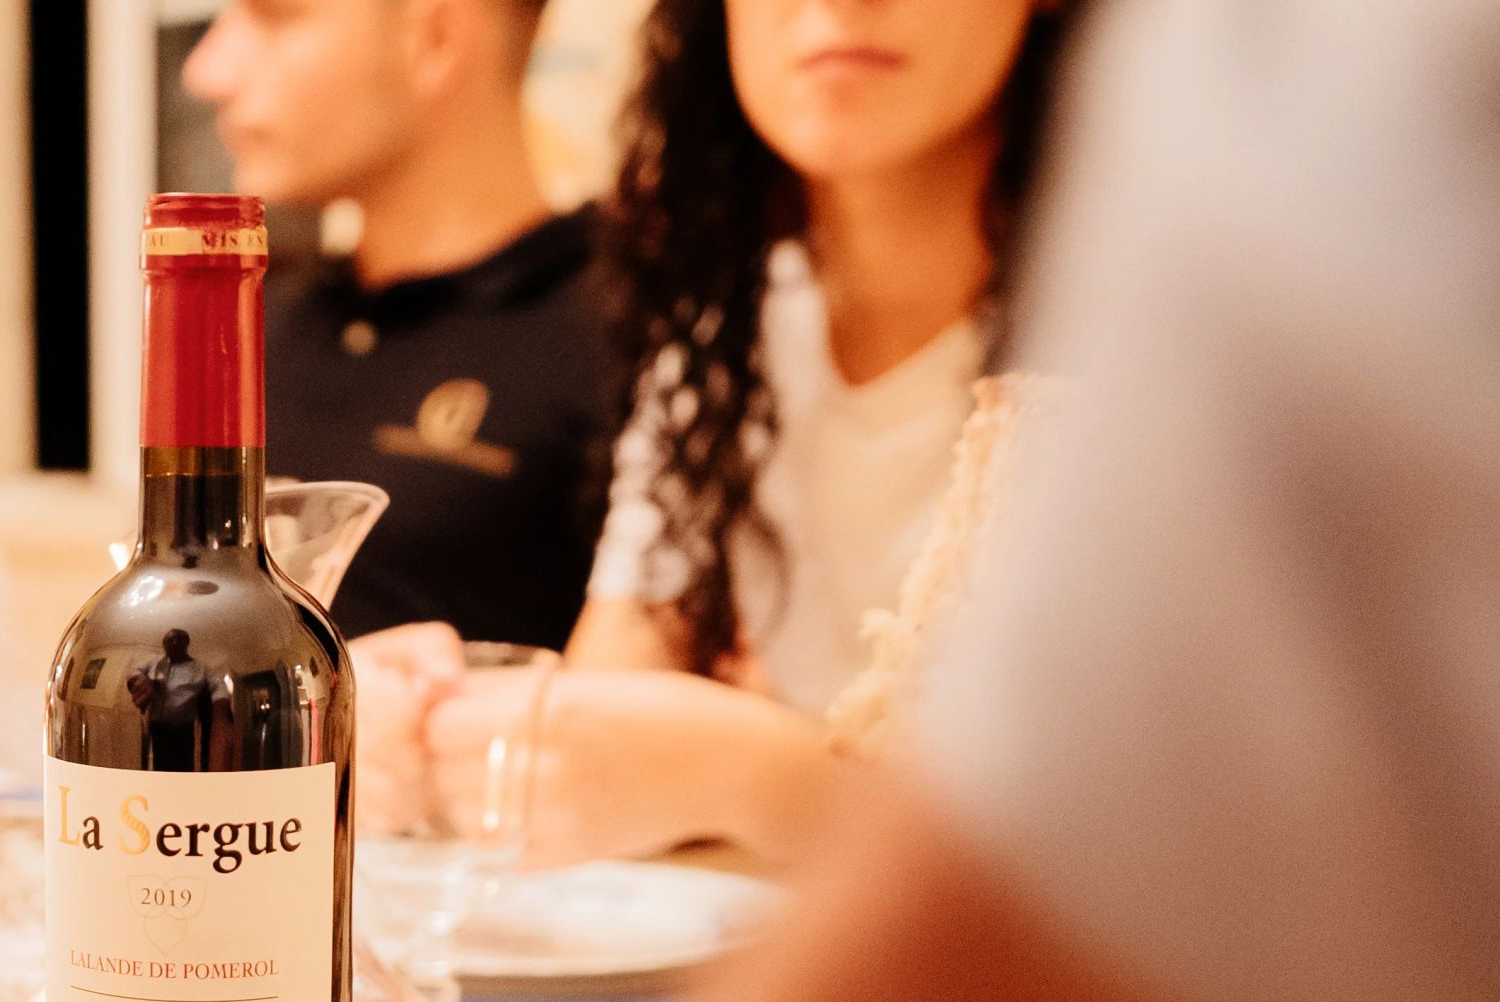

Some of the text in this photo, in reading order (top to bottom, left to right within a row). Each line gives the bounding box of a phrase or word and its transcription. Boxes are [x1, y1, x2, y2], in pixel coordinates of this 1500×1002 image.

[58, 785, 303, 874] La Sergue
[140, 887, 192, 907] 2019
[70, 949, 279, 980] LALANDE DE POMEROL
